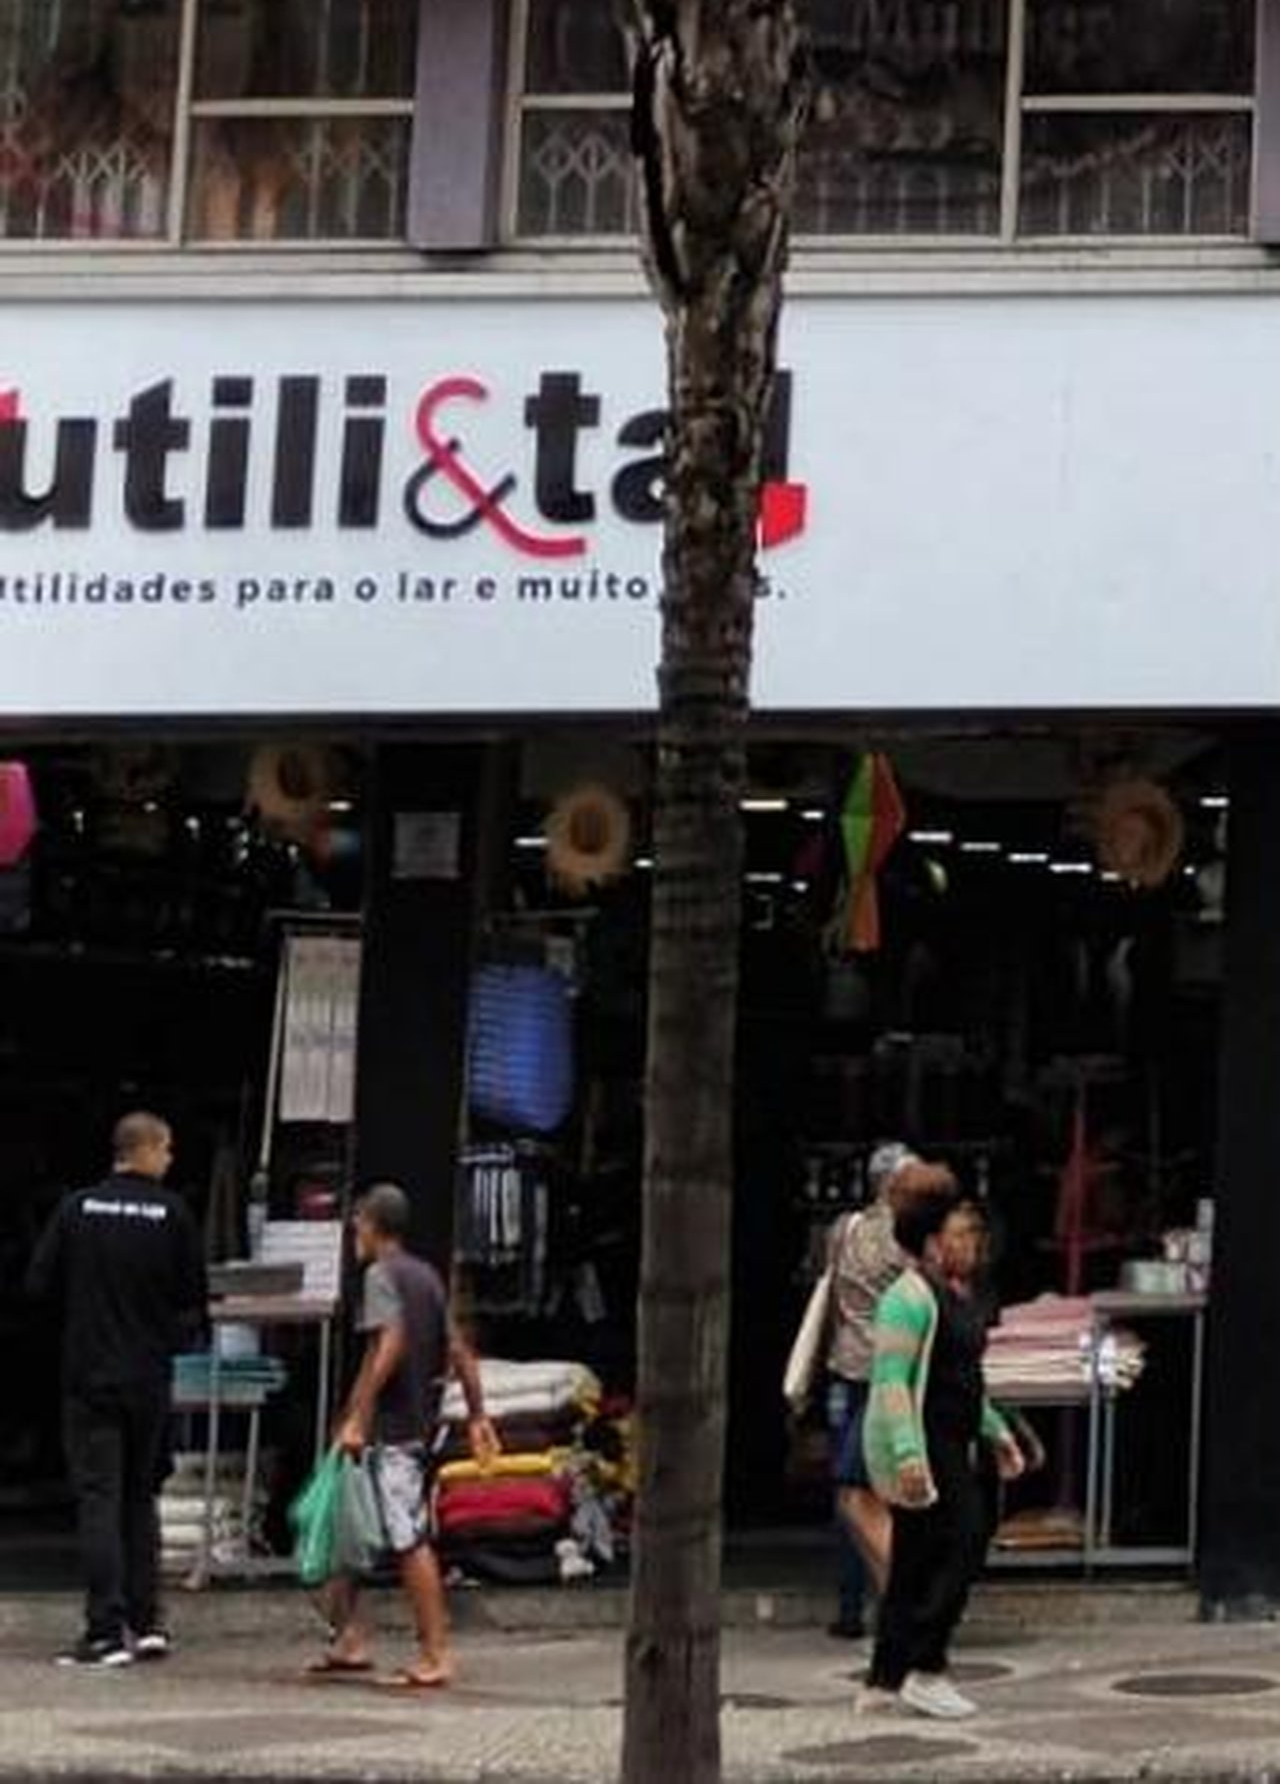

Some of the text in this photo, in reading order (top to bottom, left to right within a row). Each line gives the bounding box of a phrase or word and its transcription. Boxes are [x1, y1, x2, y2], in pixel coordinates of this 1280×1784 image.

[237, 578, 335, 610] para
[355, 577, 378, 602] o
[398, 571, 457, 602] lar
[475, 577, 497, 601] e
[517, 569, 648, 599] muito
